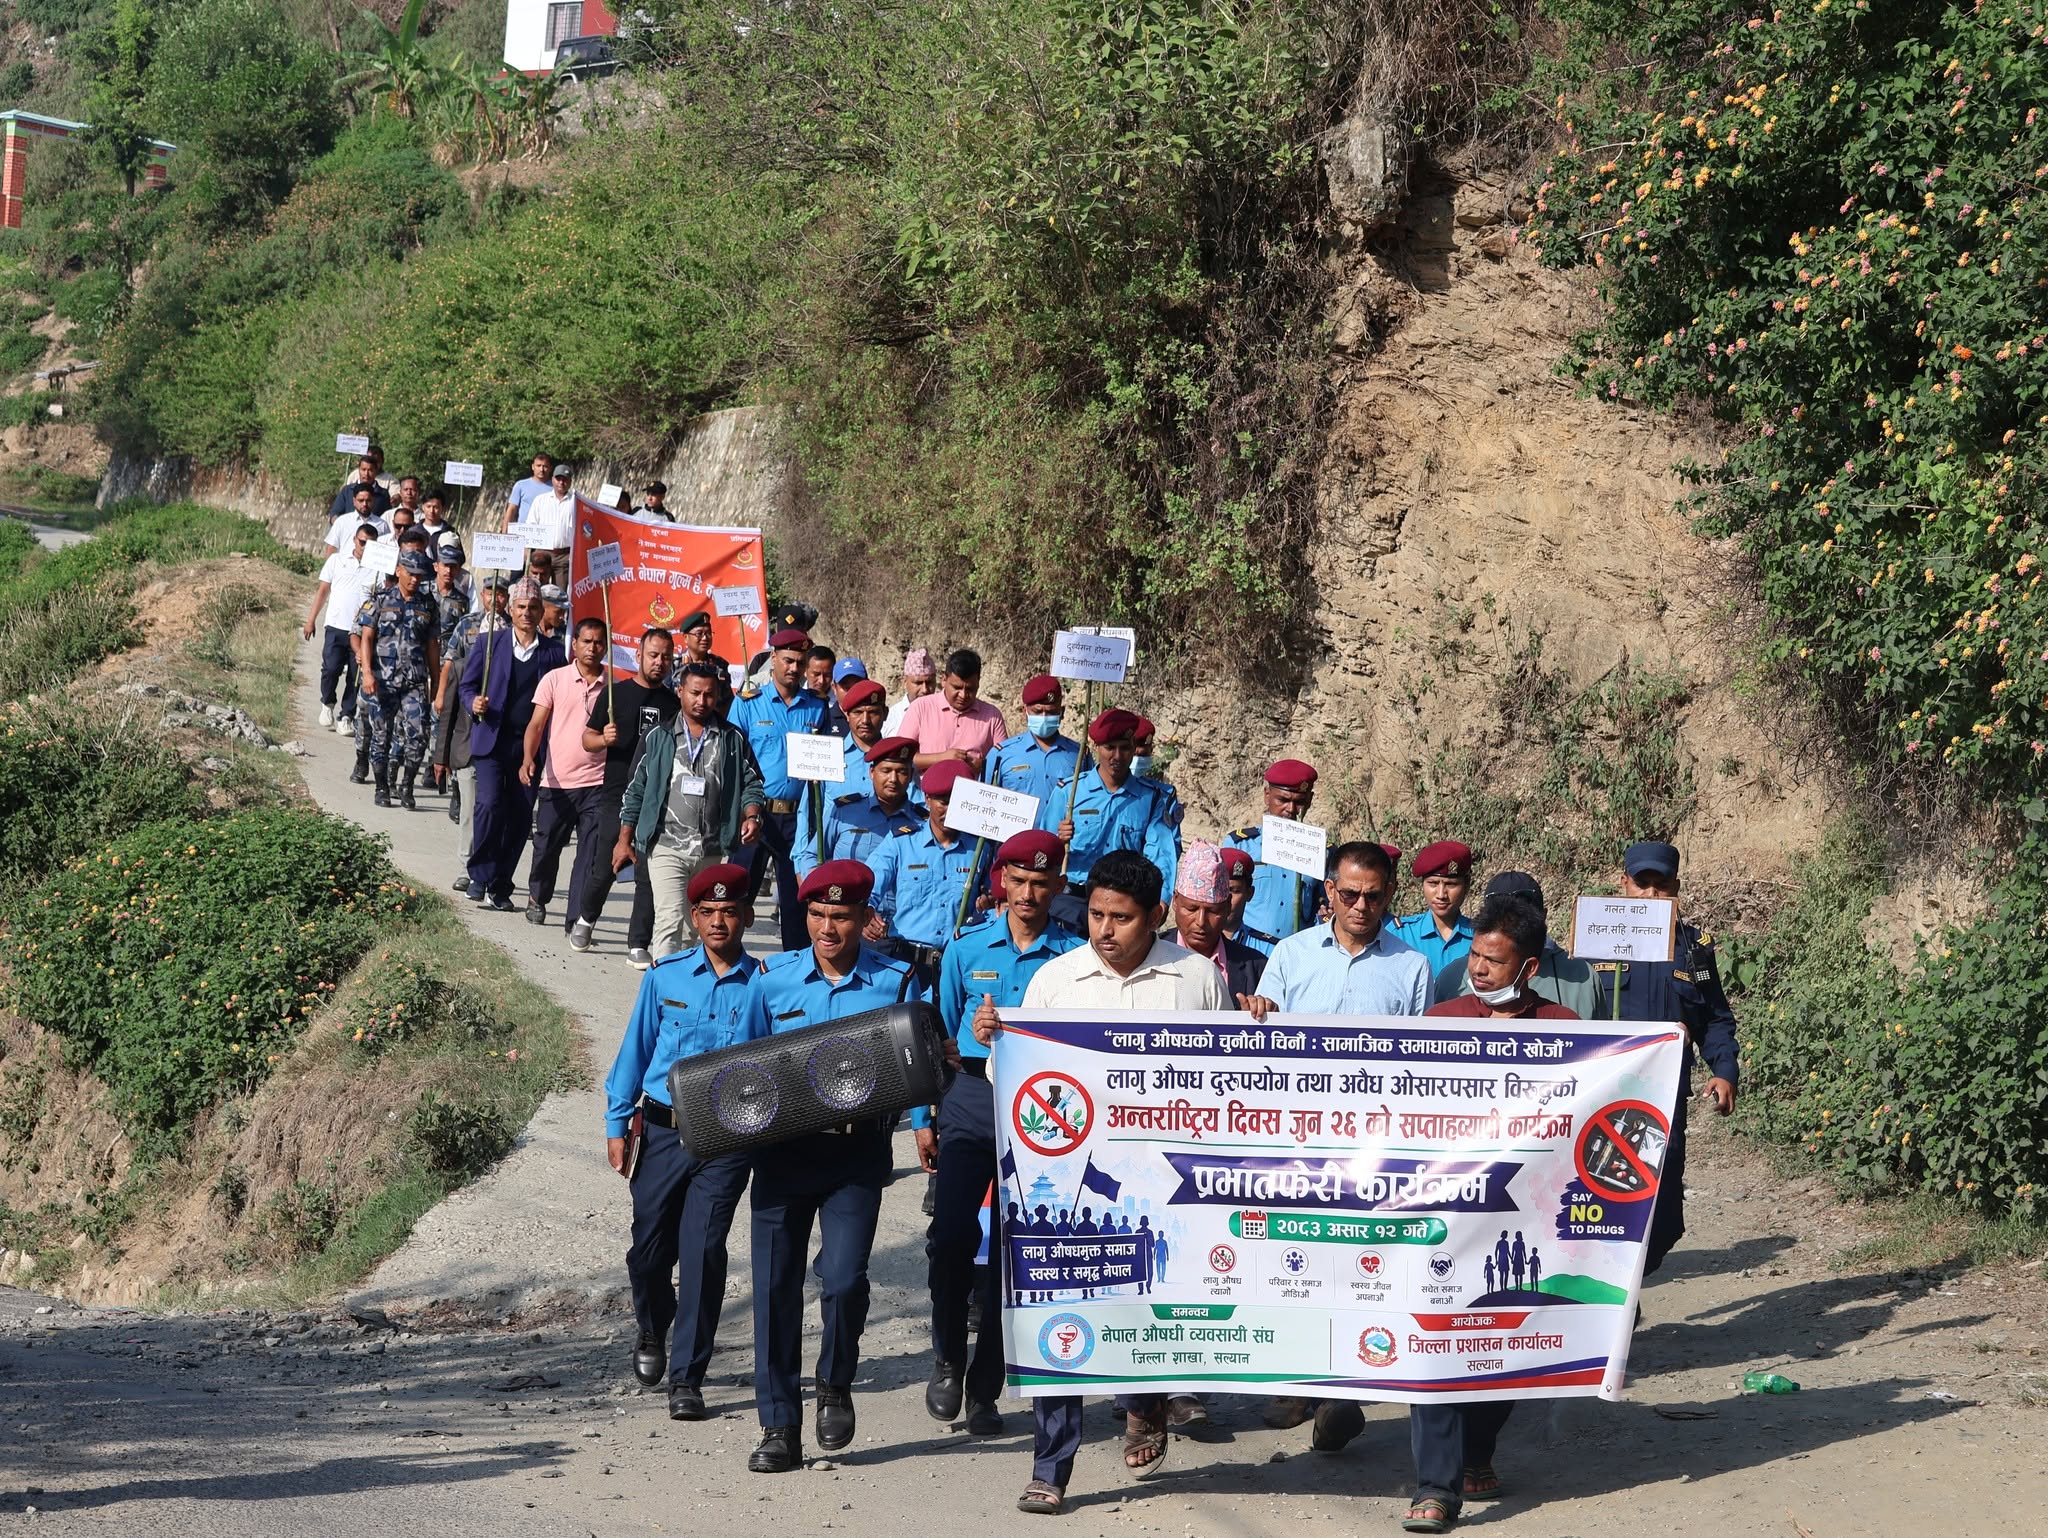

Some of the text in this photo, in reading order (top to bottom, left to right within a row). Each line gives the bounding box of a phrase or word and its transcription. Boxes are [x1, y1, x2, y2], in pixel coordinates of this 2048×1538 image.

[637, 562, 667, 584] नेपाल
[668, 570, 693, 590] गुल्म
[978, 788, 1019, 806] गलत बाटो
[1000, 811, 1029, 825] गन्तव्य
[1604, 903, 1648, 915] गलत बाटो
[1631, 925, 1663, 936] गन्तव्य
[1150, 1028, 1214, 1049] औषधको
[1219, 1029, 1266, 1053] चुनौती
[1321, 1032, 1394, 1054] सामाजिक
[1398, 1036, 1482, 1056] समाधानको
[1486, 1036, 1519, 1057] बाटो
[1106, 1068, 1146, 1095] लागु
[1152, 1063, 1204, 1090] औषध
[1296, 1072, 1333, 1093] तथा
[1339, 1067, 1384, 1095] अवैध
[1390, 1069, 1498, 1099] ओसारपसार
[1107, 1098, 1574, 1143] अन्तर्राष्ट्रिय दिवस जुन २६ को सप्ताहव्यापी कार्यक्रम
[1191, 1160, 1492, 1204] प्रभातफेरी कार्यक्रम
[1571, 1193, 1593, 1202] SAY
[1569, 1204, 1603, 1222] NO
[1276, 1218, 1430, 1239] २०८३ असार १२ गते
[1570, 1225, 1625, 1235] TO DRUGS
[1021, 1241, 1136, 1263] लागु औषधमुक्त समाज
[1029, 1262, 1132, 1282] स्वस्थ र समृद्ध नेपाल
[1203, 1275, 1242, 1287] लागु औषध
[1268, 1276, 1322, 1288] परिवार र समाज
[1350, 1281, 1392, 1291] स्वस्थ जीवन
[1421, 1284, 1463, 1293] सचेत समाज
[1170, 1307, 1210, 1318] समन्वय
[1101, 1324, 1137, 1343] नेपाल
[1142, 1324, 1185, 1342] औषधी
[1188, 1324, 1248, 1343] व्यवसायी
[1252, 1325, 1275, 1344] संघ
[1408, 1332, 1564, 1354] जिल्ला प्रशासन कार्यालय
[1131, 1349, 1250, 1366] जिल्ला शाखा, सल्यान
[1466, 1359, 1504, 1372] सल्यान
